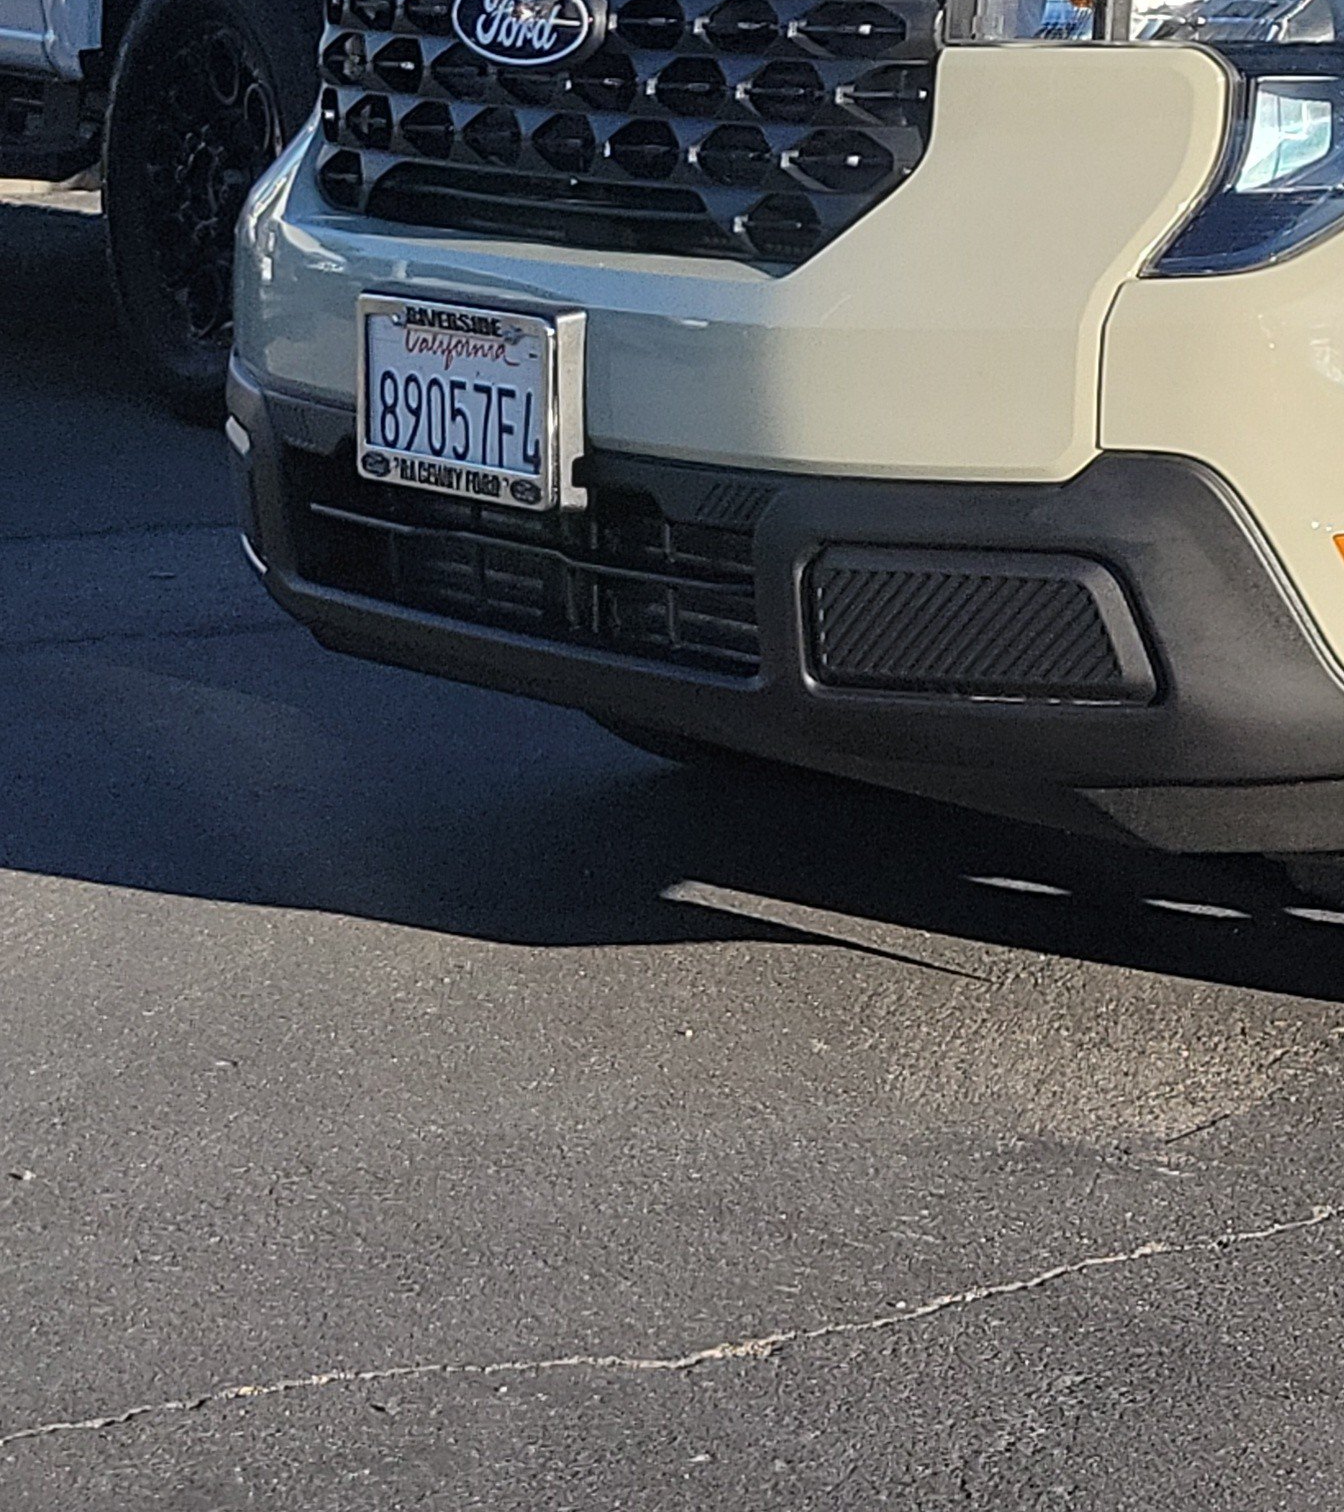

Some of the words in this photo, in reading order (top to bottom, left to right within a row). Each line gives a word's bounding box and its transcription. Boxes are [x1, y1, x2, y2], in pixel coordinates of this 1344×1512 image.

[405, 306, 503, 337] RIVERSIDE
[405, 329, 520, 370] California
[380, 370, 542, 476] 89057F4
[465, 470, 500, 497] FORD
